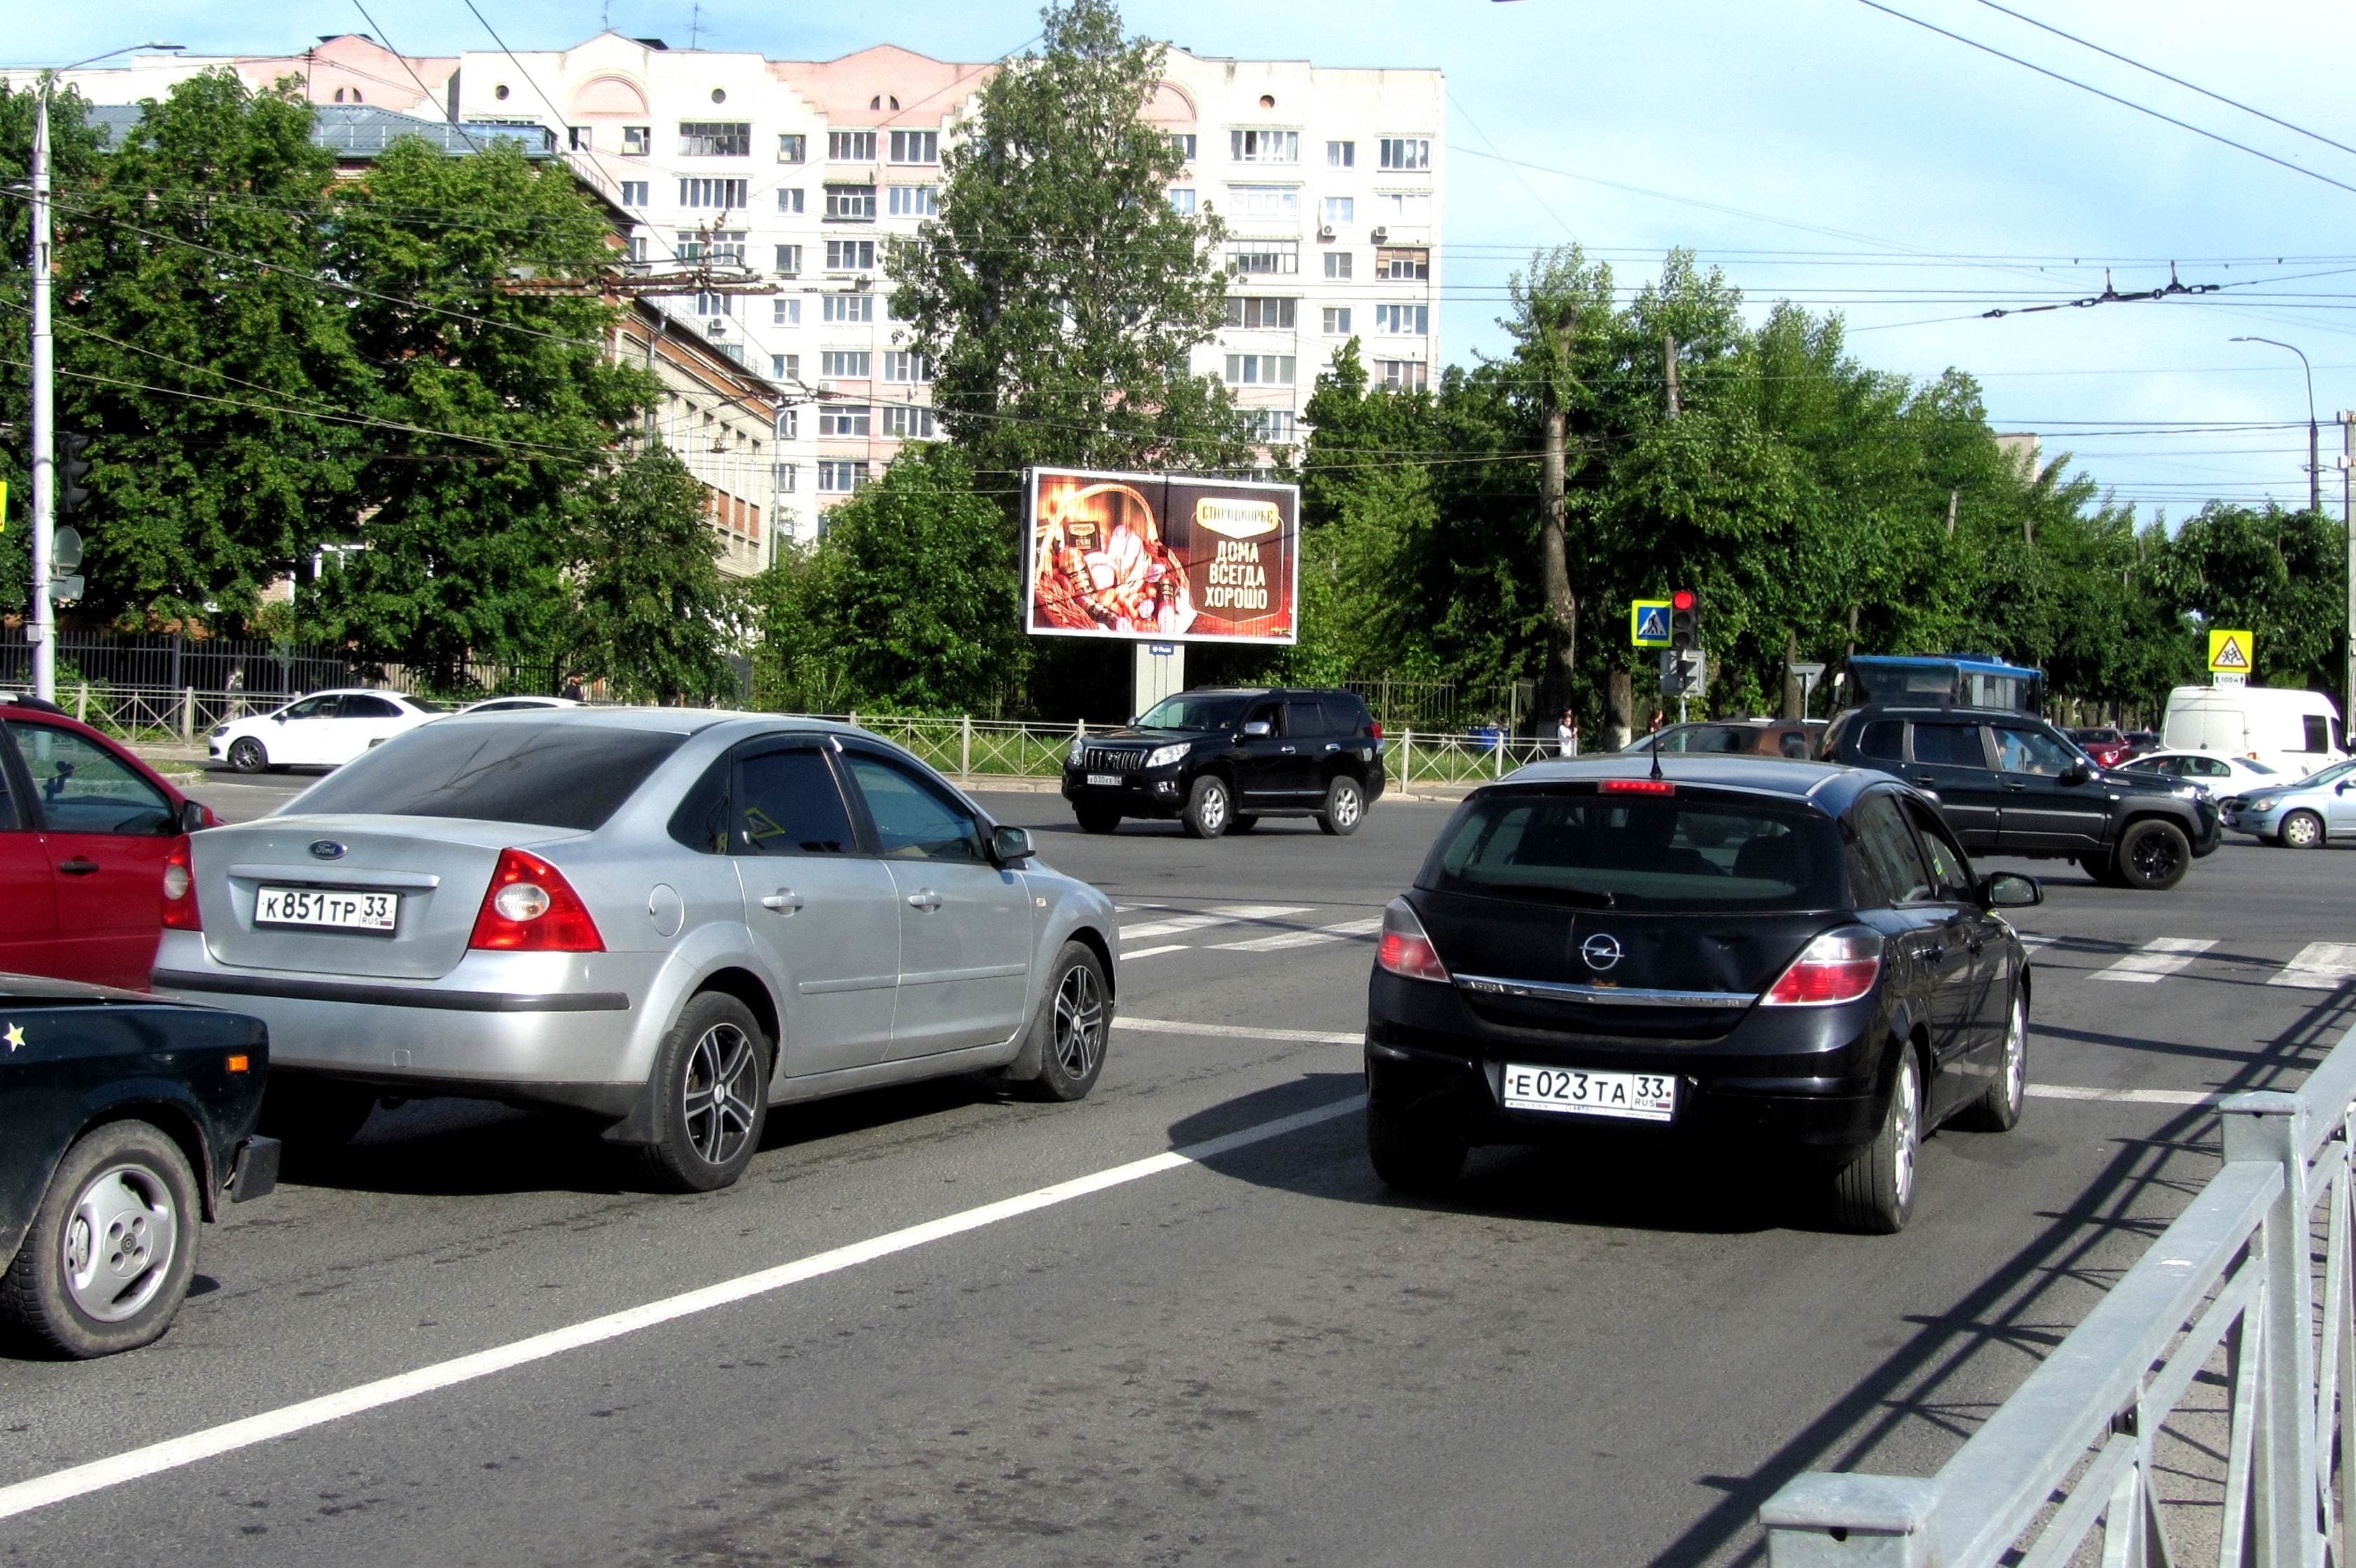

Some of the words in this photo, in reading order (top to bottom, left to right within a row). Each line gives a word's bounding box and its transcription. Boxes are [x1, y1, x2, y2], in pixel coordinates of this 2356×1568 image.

[1215, 540, 1259, 564] ДОМА
[1209, 563, 1266, 589] ВСЕГДА
[1204, 586, 1268, 610] ХОРОШО
[364, 896, 387, 917] 33
[361, 917, 379, 926] RUS
[1637, 1077, 1664, 1098] 33
[1634, 1098, 1655, 1108] RUS
